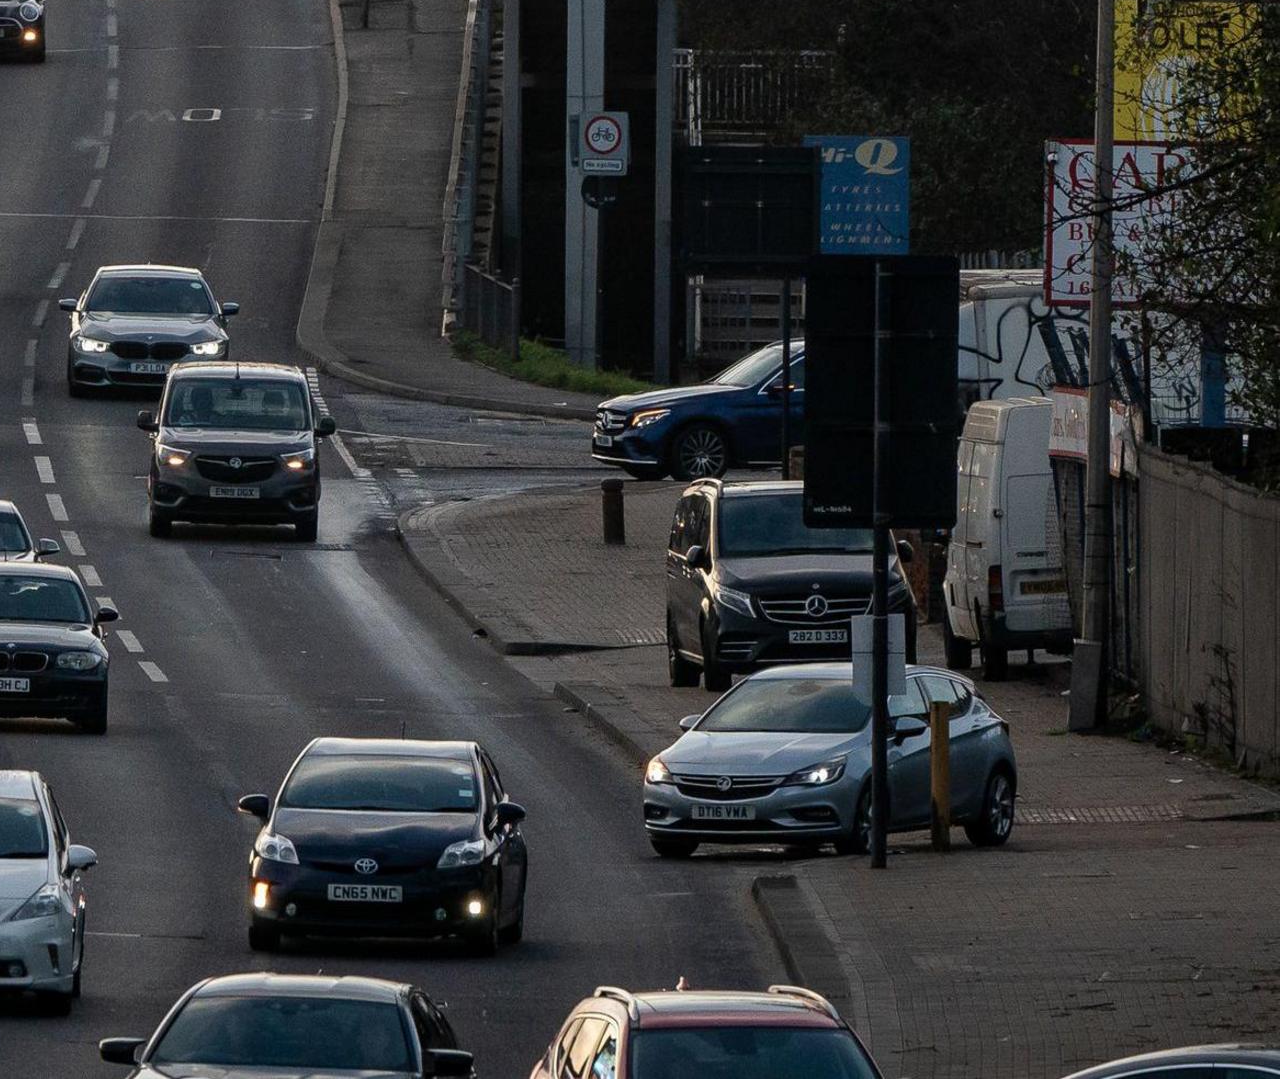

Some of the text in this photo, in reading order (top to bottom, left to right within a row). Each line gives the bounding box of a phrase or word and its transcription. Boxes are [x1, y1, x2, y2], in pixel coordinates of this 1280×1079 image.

[831, 185, 882, 194] TYRES
[823, 203, 902, 213] ATTERIES
[698, 805, 722, 818] DT16
[333, 886, 368, 899] CN65
